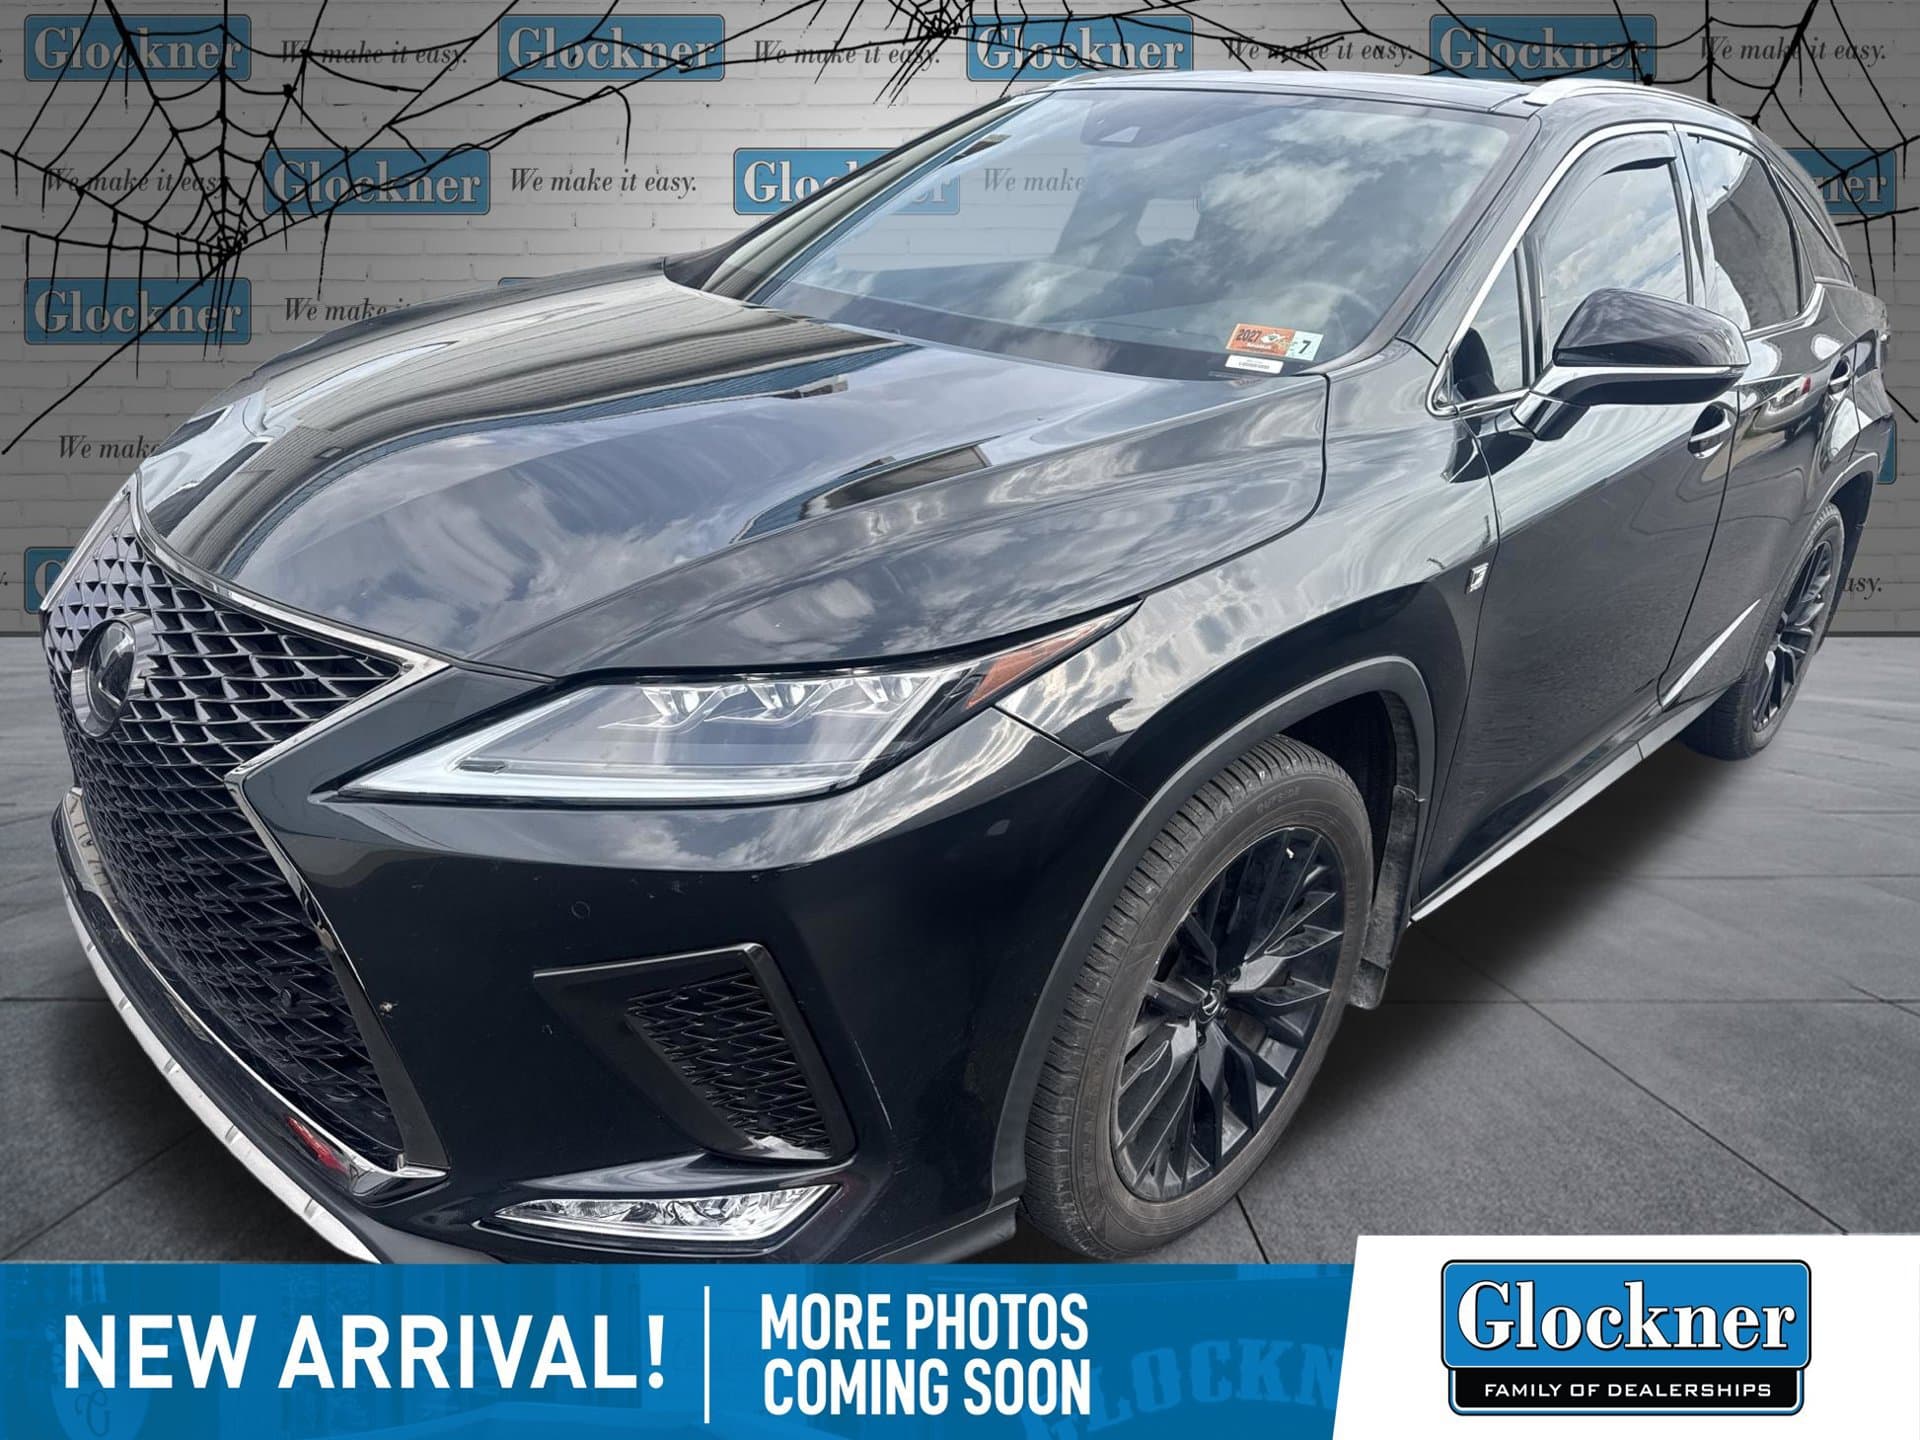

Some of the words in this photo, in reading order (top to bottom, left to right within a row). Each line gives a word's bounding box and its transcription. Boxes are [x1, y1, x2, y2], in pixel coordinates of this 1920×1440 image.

[34, 26, 243, 70] Glockner
[322, 40, 384, 64] make
[391, 40, 409, 64] it
[415, 47, 467, 72] easy.
[507, 26, 715, 70] Glockner
[754, 40, 787, 64] We
[976, 26, 1185, 70] Glockner
[1361, 43, 1413, 68] easy.
[1439, 26, 1648, 70] Glockner
[1700, 36, 1733, 60] We
[1810, 36, 1827, 60] it
[1834, 43, 1886, 68] easy.
[47, 168, 79, 192] We
[87, 168, 149, 192] make
[156, 168, 176, 192] it
[273, 159, 481, 203] Glockner
[510, 168, 544, 192] We
[551, 168, 613, 192] make
[620, 168, 637, 192] it
[644, 175, 697, 200] easy.
[984, 168, 1016, 192] We
[34, 289, 243, 333] Glockner
[285, 297, 318, 321] We
[1235, 329, 1263, 343] 2027
[1298, 340, 1312, 354] 7
[59, 434, 92, 459] We
